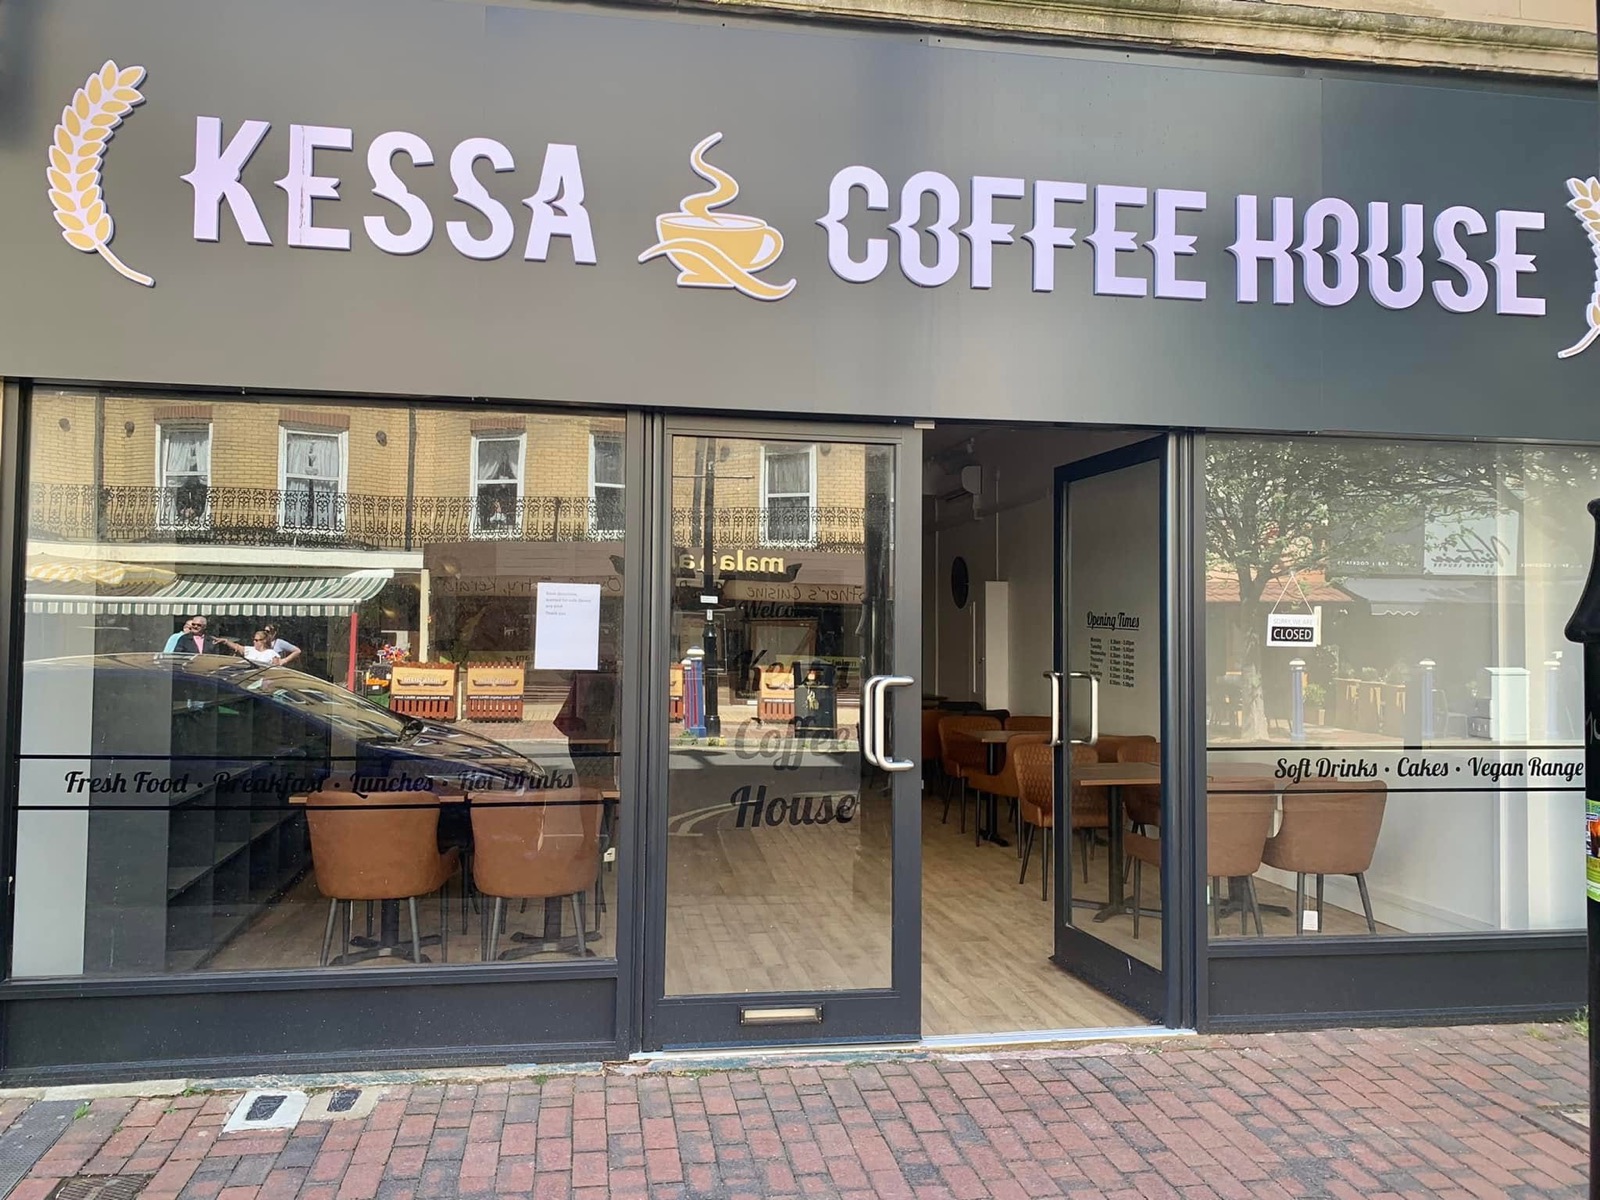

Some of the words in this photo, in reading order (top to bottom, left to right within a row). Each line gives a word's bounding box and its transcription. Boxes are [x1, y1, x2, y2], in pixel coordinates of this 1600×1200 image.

[180, 115, 597, 266] KESSA
[815, 165, 1208, 301] COFFEE
[1225, 193, 1546, 317] HOUSE
[1086, 610, 1117, 631] Opening
[1117, 611, 1140, 628] Times
[1273, 628, 1312, 640] CLOSED
[734, 715, 850, 771] Coffee
[64, 770, 127, 794] Fresh
[133, 771, 188, 793] Food
[212, 771, 324, 800] Breakfast
[350, 771, 434, 798] Lunches
[502, 769, 574, 791] Drinks
[1274, 757, 1312, 784] Soft
[1315, 758, 1378, 778] Drinks
[1397, 757, 1450, 777] Cakes
[1468, 757, 1524, 782] Vegan
[1528, 757, 1585, 782] Range
[730, 785, 860, 828] House
